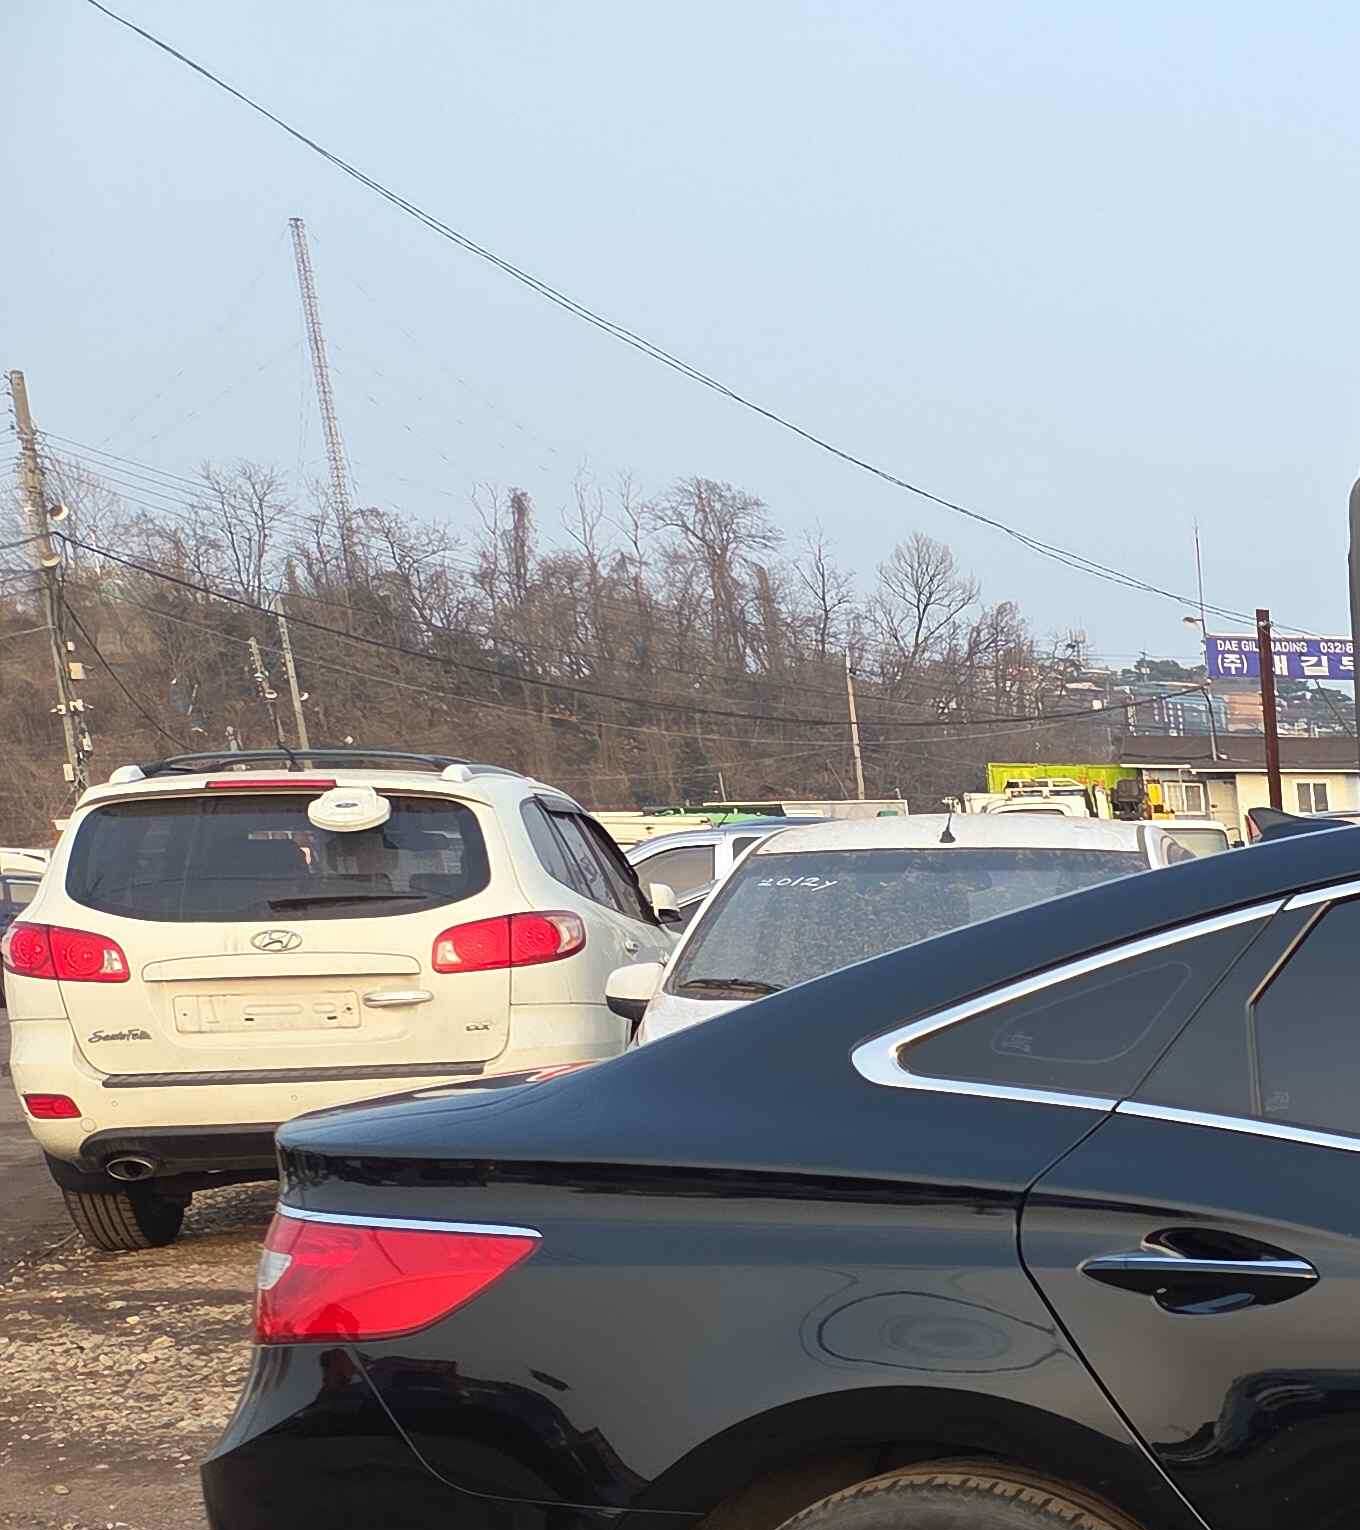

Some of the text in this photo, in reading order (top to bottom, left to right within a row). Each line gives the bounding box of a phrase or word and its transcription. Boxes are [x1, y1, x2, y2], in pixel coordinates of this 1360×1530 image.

[1216, 639, 1239, 652] DAE
[1241, 639, 1260, 653] GIL
[1217, 653, 1249, 675] (주)
